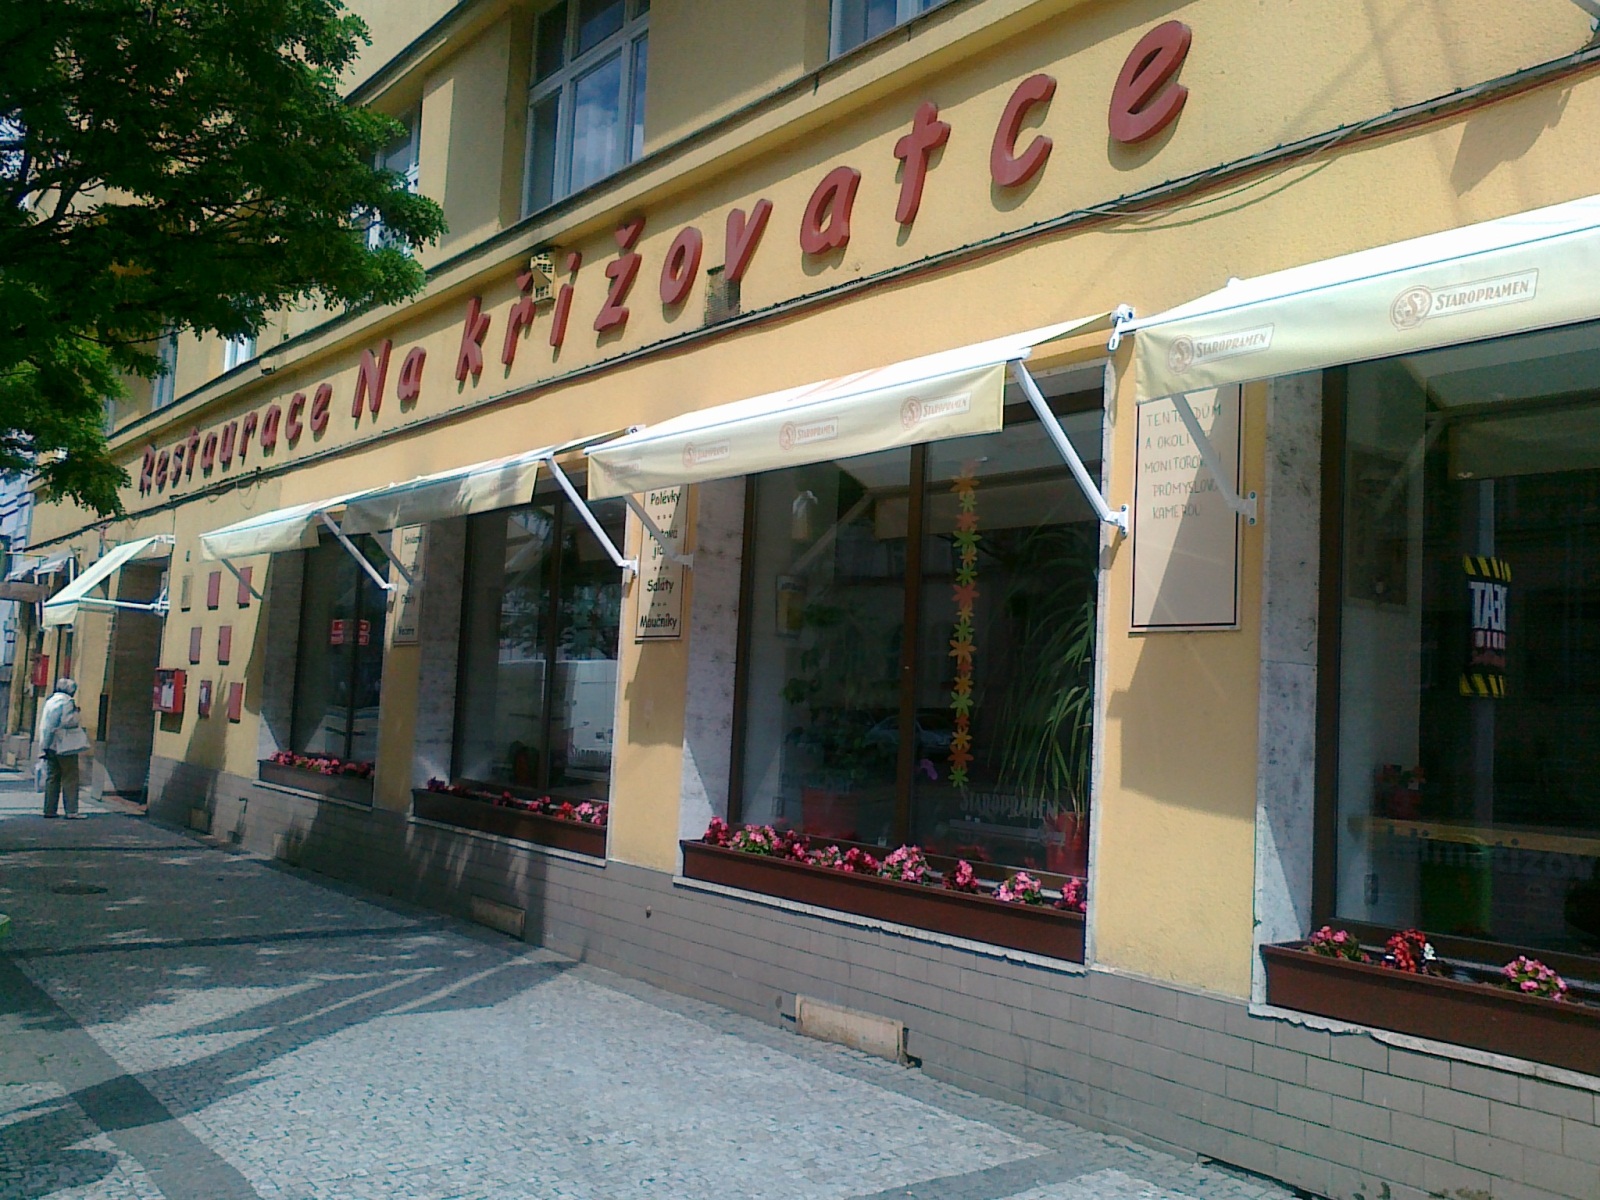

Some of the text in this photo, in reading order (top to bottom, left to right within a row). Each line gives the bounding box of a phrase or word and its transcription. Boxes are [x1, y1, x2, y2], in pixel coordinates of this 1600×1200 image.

[1435, 279, 1529, 311] STAROPRAMEN
[1196, 333, 1267, 358] STAROPRAMEN
[139, 383, 332, 492] Restaurace
[352, 339, 427, 418] Na
